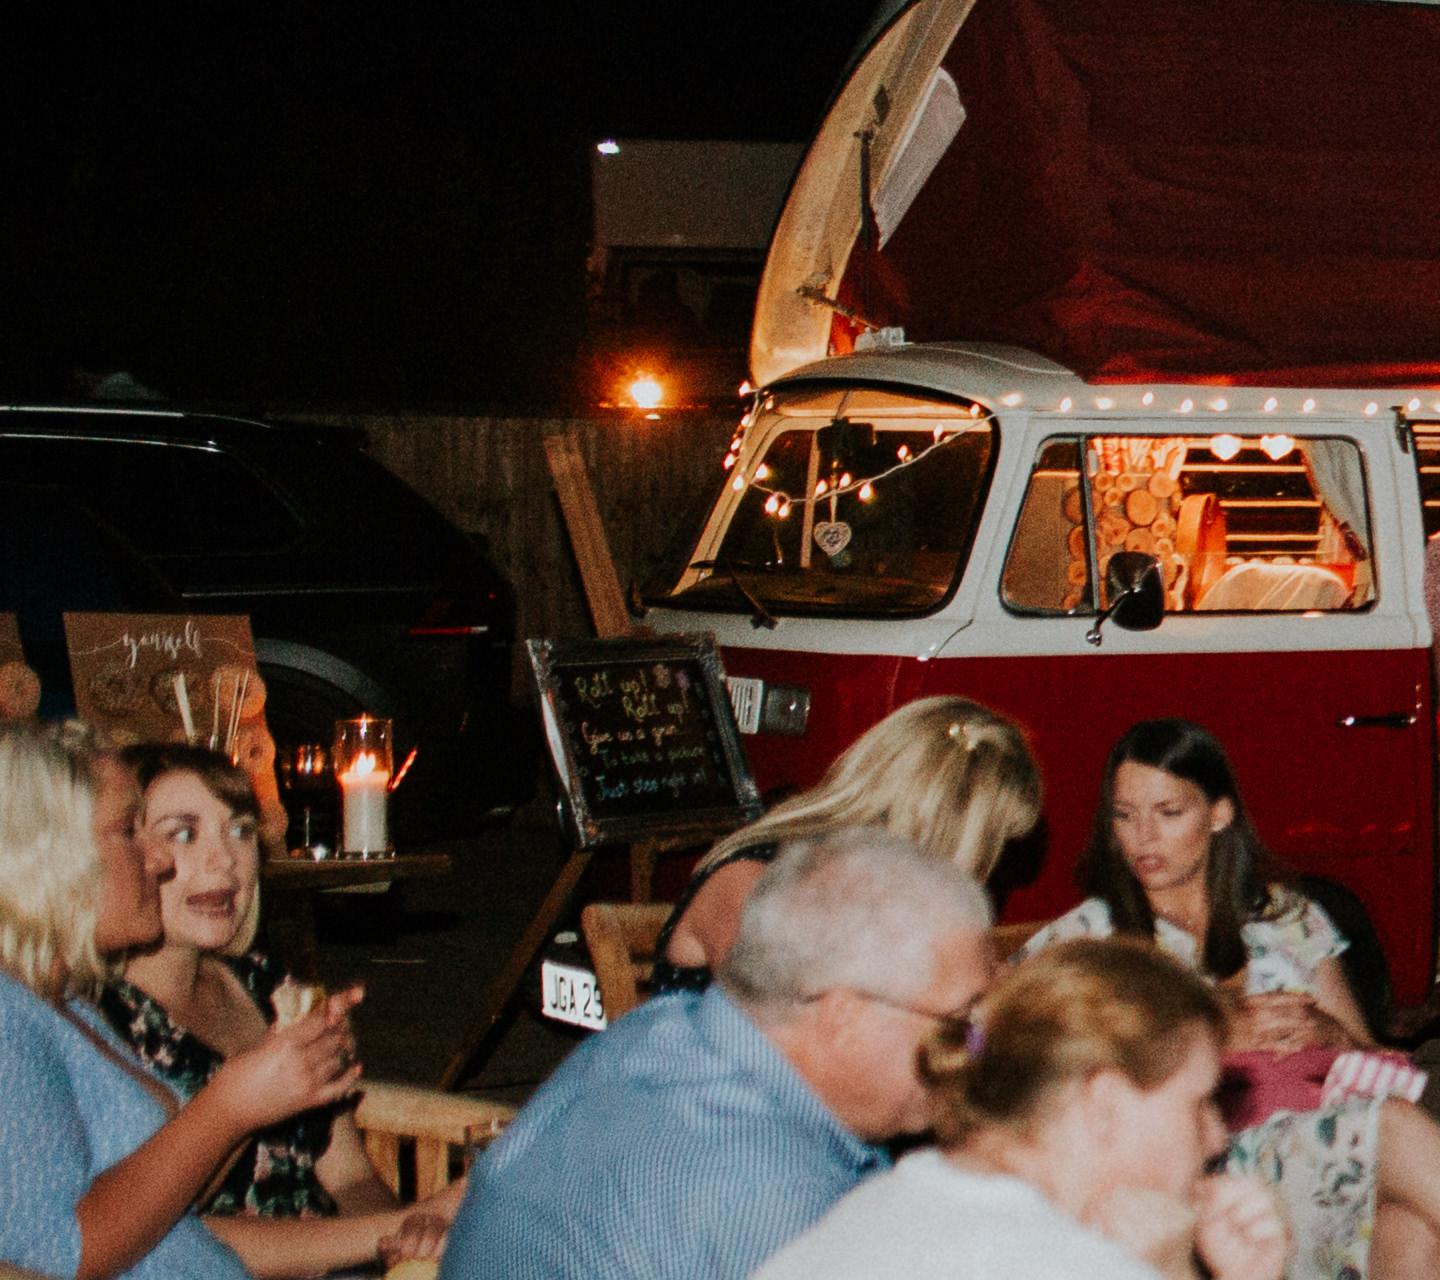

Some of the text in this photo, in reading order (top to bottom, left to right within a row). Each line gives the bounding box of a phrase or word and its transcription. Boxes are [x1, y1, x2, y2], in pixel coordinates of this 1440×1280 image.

[574, 671, 614, 709] Roll
[621, 693, 661, 723] Roll
[551, 973, 578, 1017] JGA
